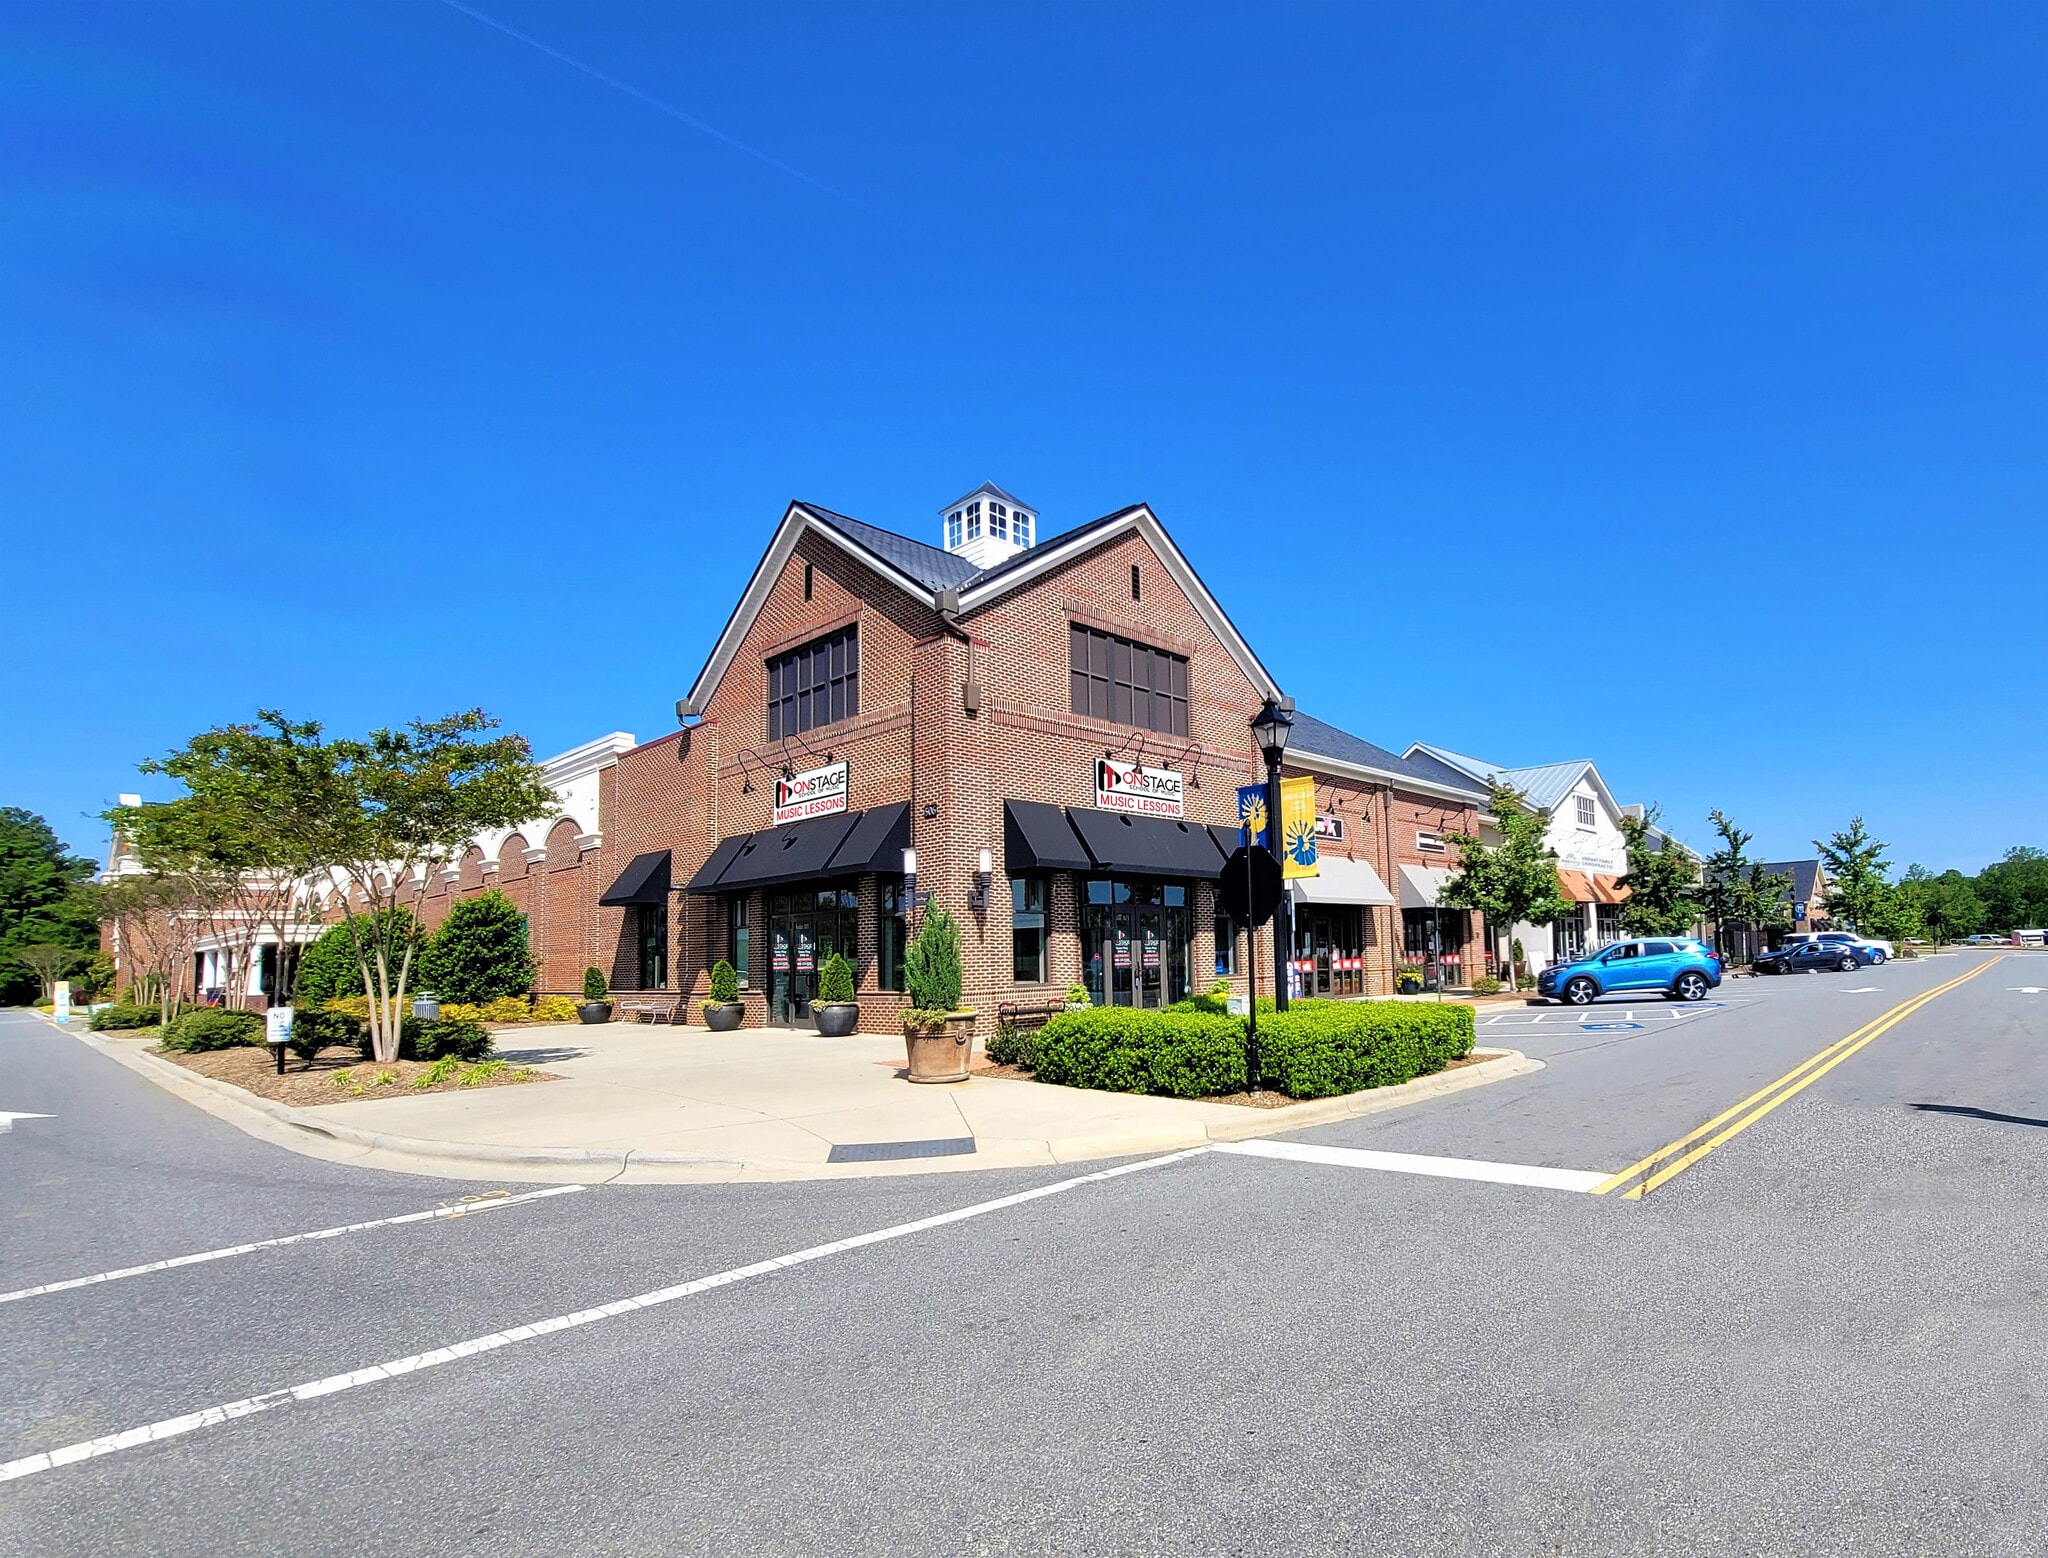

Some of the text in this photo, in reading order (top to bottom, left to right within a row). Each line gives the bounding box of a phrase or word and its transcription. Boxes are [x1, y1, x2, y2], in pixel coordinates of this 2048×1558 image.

[793, 770, 845, 794] ONSTAGE
[1123, 771, 1181, 793] ONSTAGE
[1129, 785, 1150, 793] SCHOOL
[776, 796, 845, 821] MUSIC LESSONS
[1100, 793, 1181, 815] MUSIC LESSONS
[1581, 861, 1613, 870] CHIROPRACTIC
